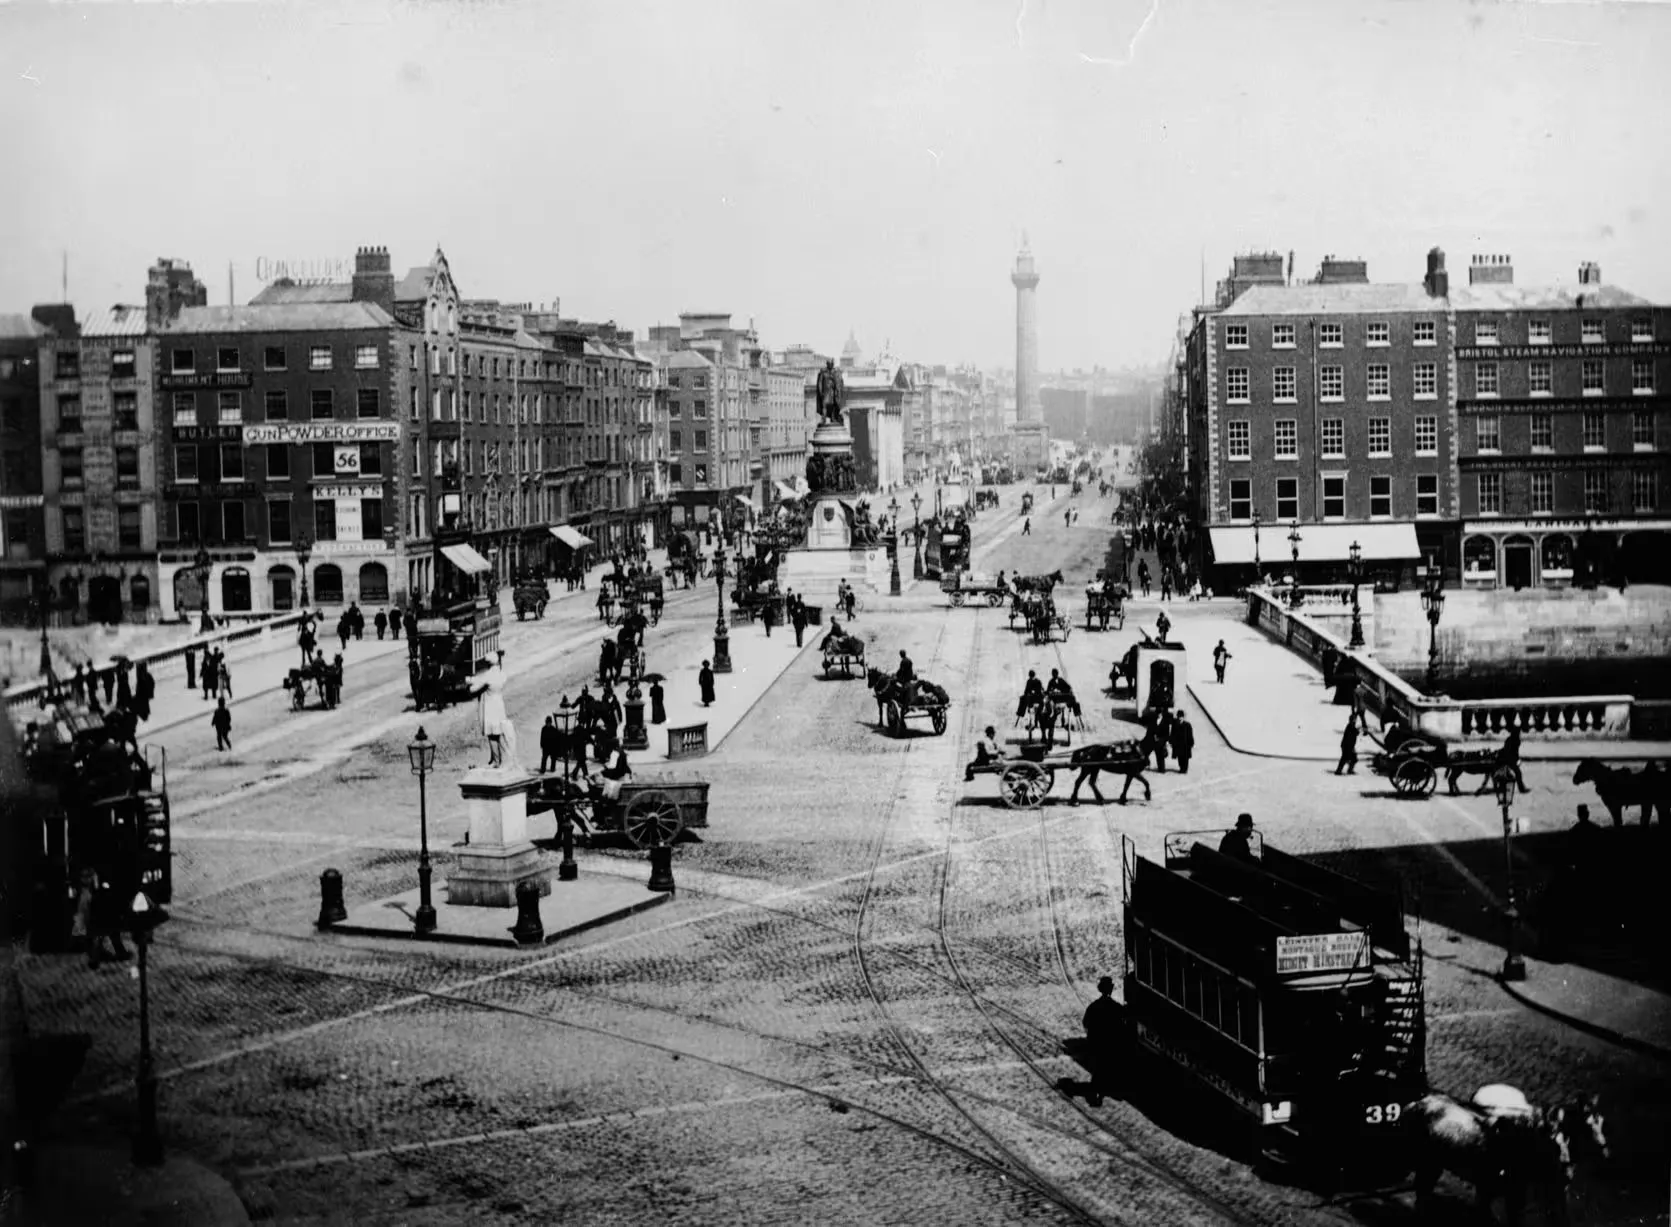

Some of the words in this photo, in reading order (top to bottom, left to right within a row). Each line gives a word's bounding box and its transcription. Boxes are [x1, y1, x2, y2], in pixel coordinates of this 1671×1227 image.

[1459, 349, 1499, 357] BRISTOL
[1503, 347, 1538, 357] STEAM
[1542, 345, 1610, 356] NAVIGATION
[247, 426, 347, 440] GUNPOWDER
[336, 453, 357, 468] 56
[1366, 1103, 1400, 1123] 39
